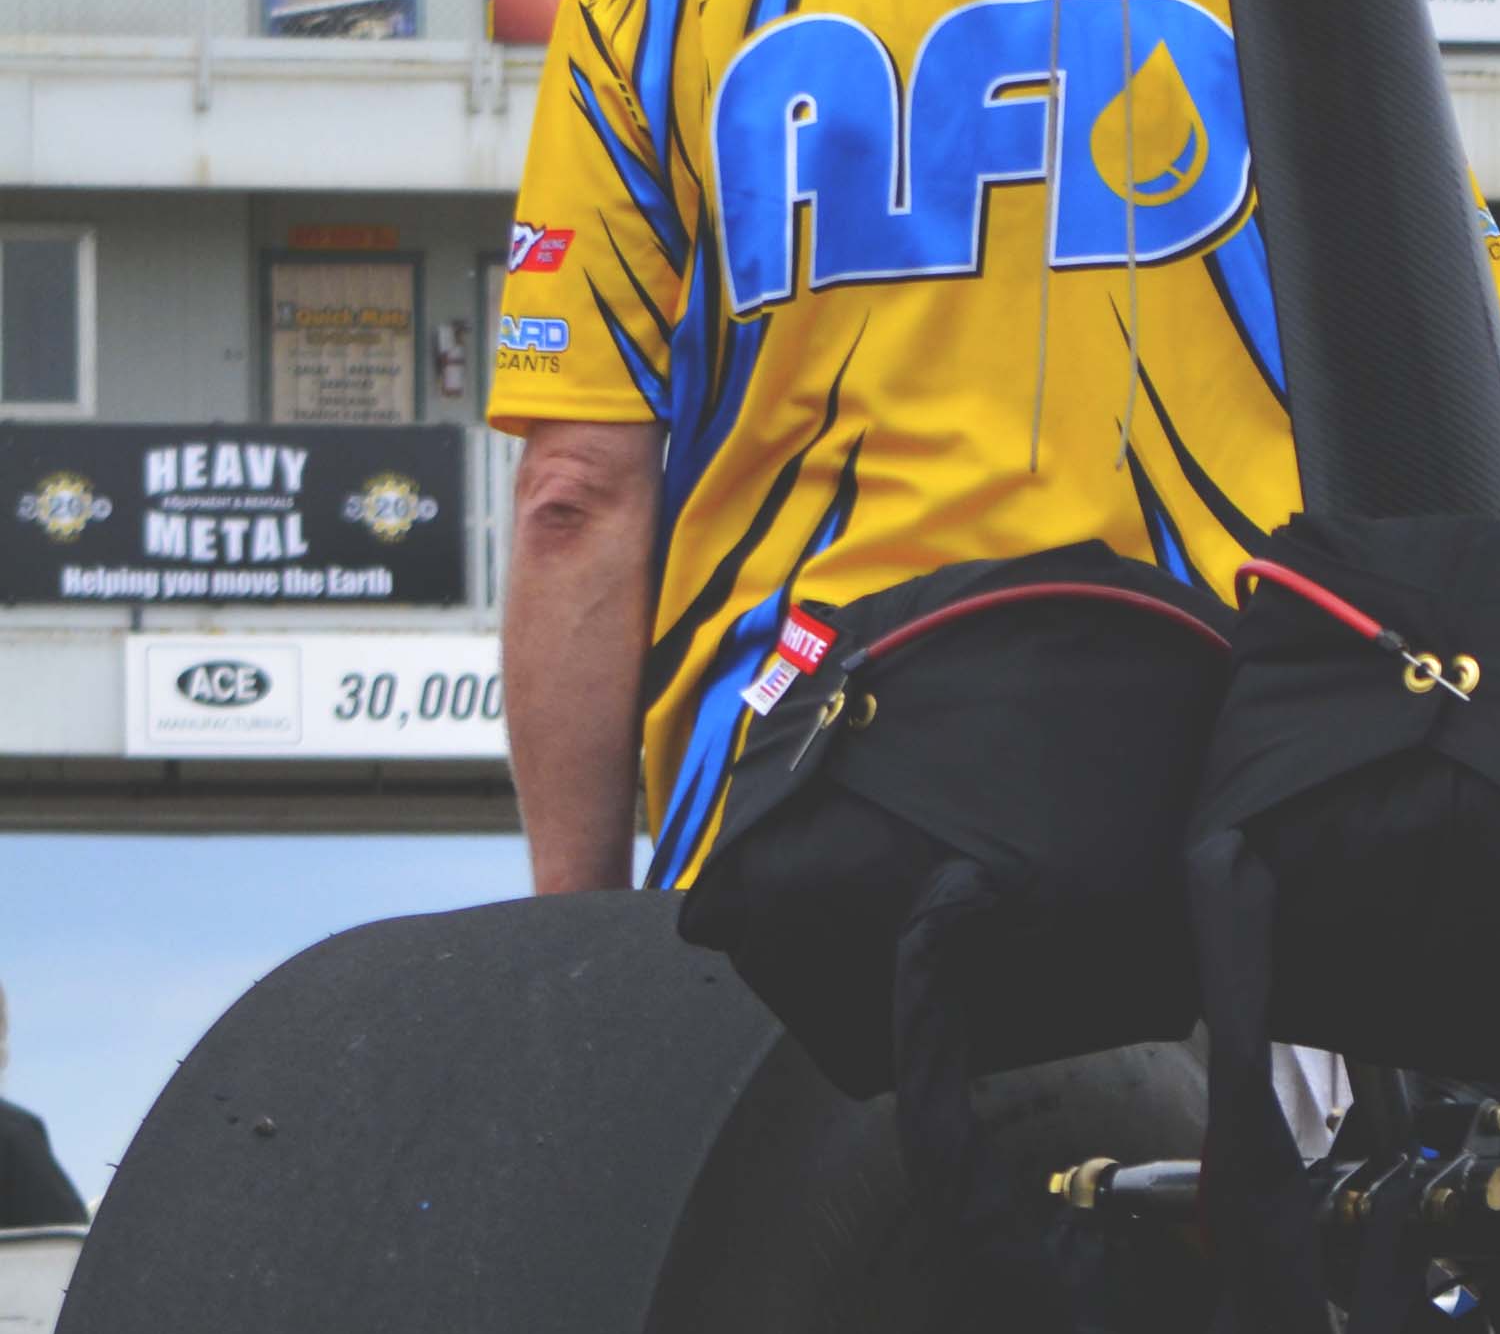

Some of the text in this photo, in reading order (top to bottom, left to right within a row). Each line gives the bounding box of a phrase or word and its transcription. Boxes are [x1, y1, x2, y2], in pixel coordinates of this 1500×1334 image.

[500, 316, 569, 352] ARD
[497, 352, 560, 373] CANTS
[144, 443, 308, 494] HEAVY
[144, 511, 308, 563] METAL
[62, 568, 392, 598] Helping you move the Earth
[189, 668, 258, 701] ACE
